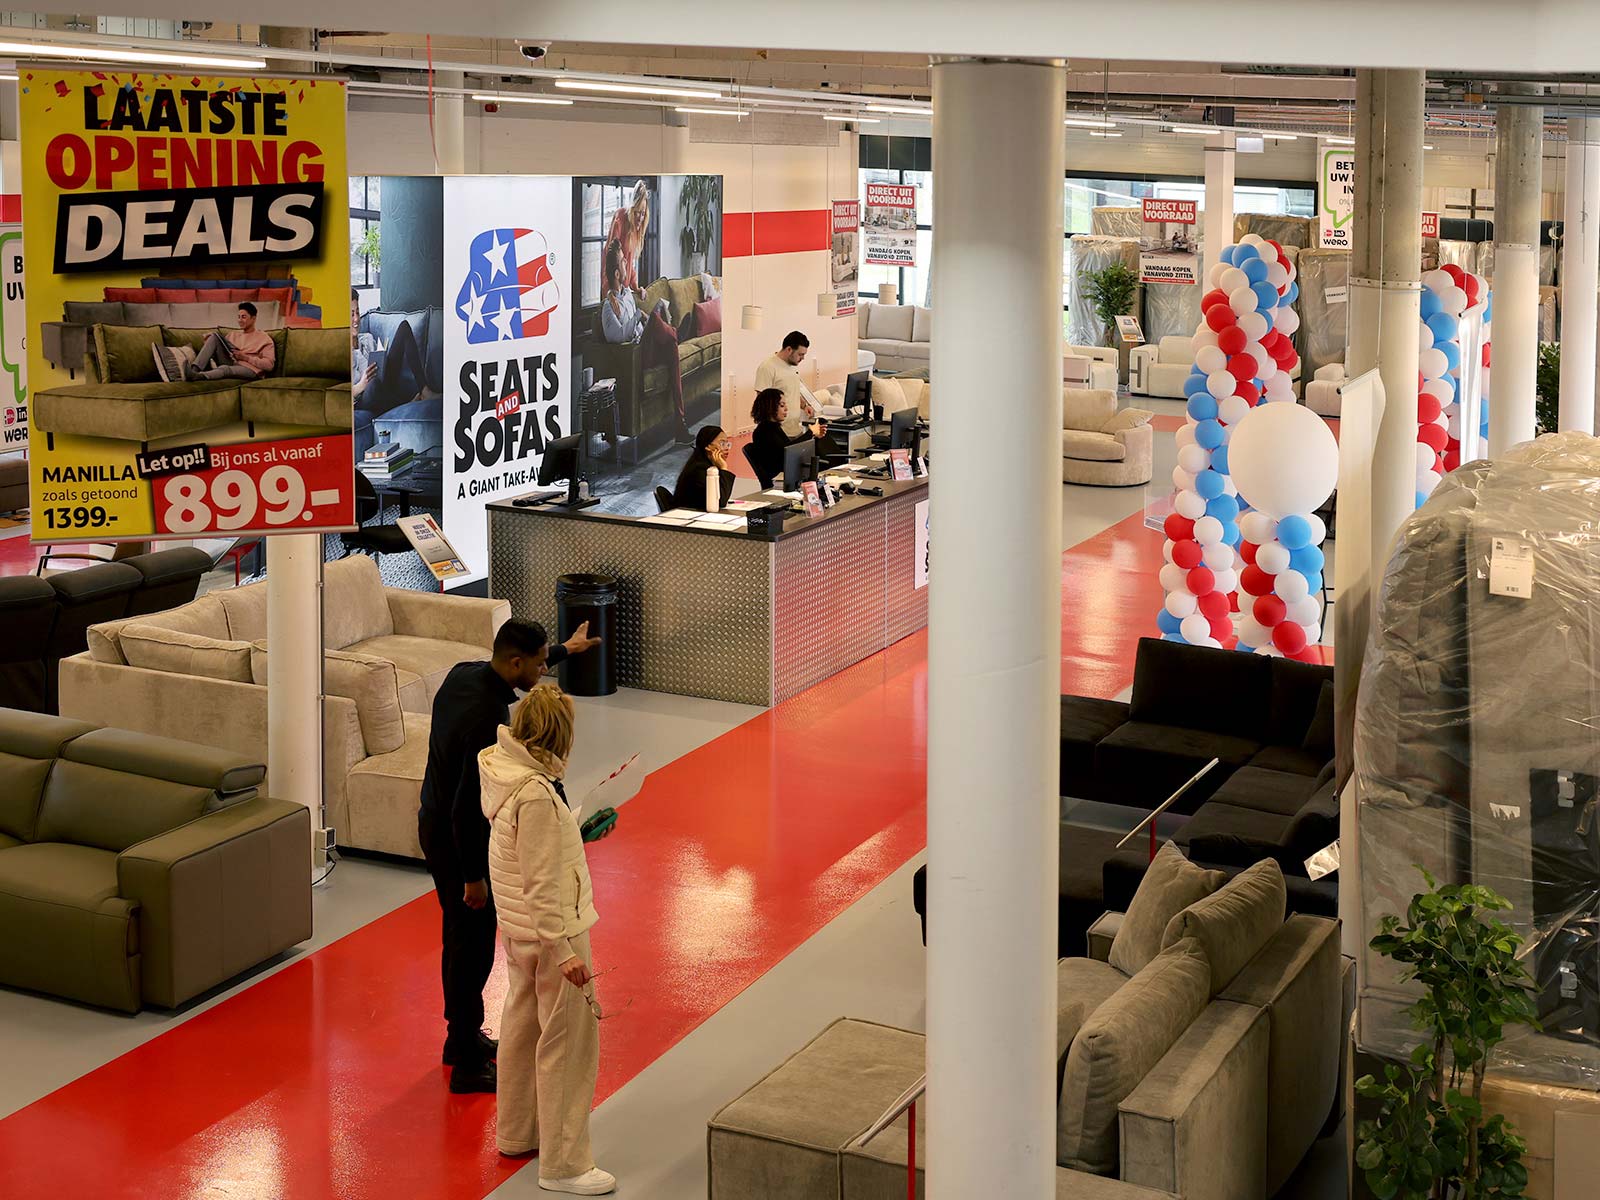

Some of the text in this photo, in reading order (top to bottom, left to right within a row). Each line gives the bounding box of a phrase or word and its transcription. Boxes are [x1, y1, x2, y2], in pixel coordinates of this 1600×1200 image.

[84, 85, 288, 136] LAATSTE
[45, 133, 325, 190] OPENING
[1330, 173, 1349, 182] UW
[868, 195, 913, 205] VOORRAAD
[869, 186, 913, 196] DIRECT UIT
[1144, 210, 1194, 220] VOORRAAD
[1145, 200, 1194, 211] DIRECT UIT
[65, 193, 316, 264] DEALS
[459, 352, 559, 417] SEATS
[497, 395, 518, 417] AND
[454, 404, 562, 474] SOFAS
[140, 442, 324, 474] Let op!! Bij ons al vanaf
[42, 465, 136, 484] MANILLA
[457, 465, 541, 500] A GIANT TAKE-A
[42, 486, 138, 504] zoals getoond
[163, 464, 340, 534] 899.-
[43, 506, 118, 529] 1399.-
